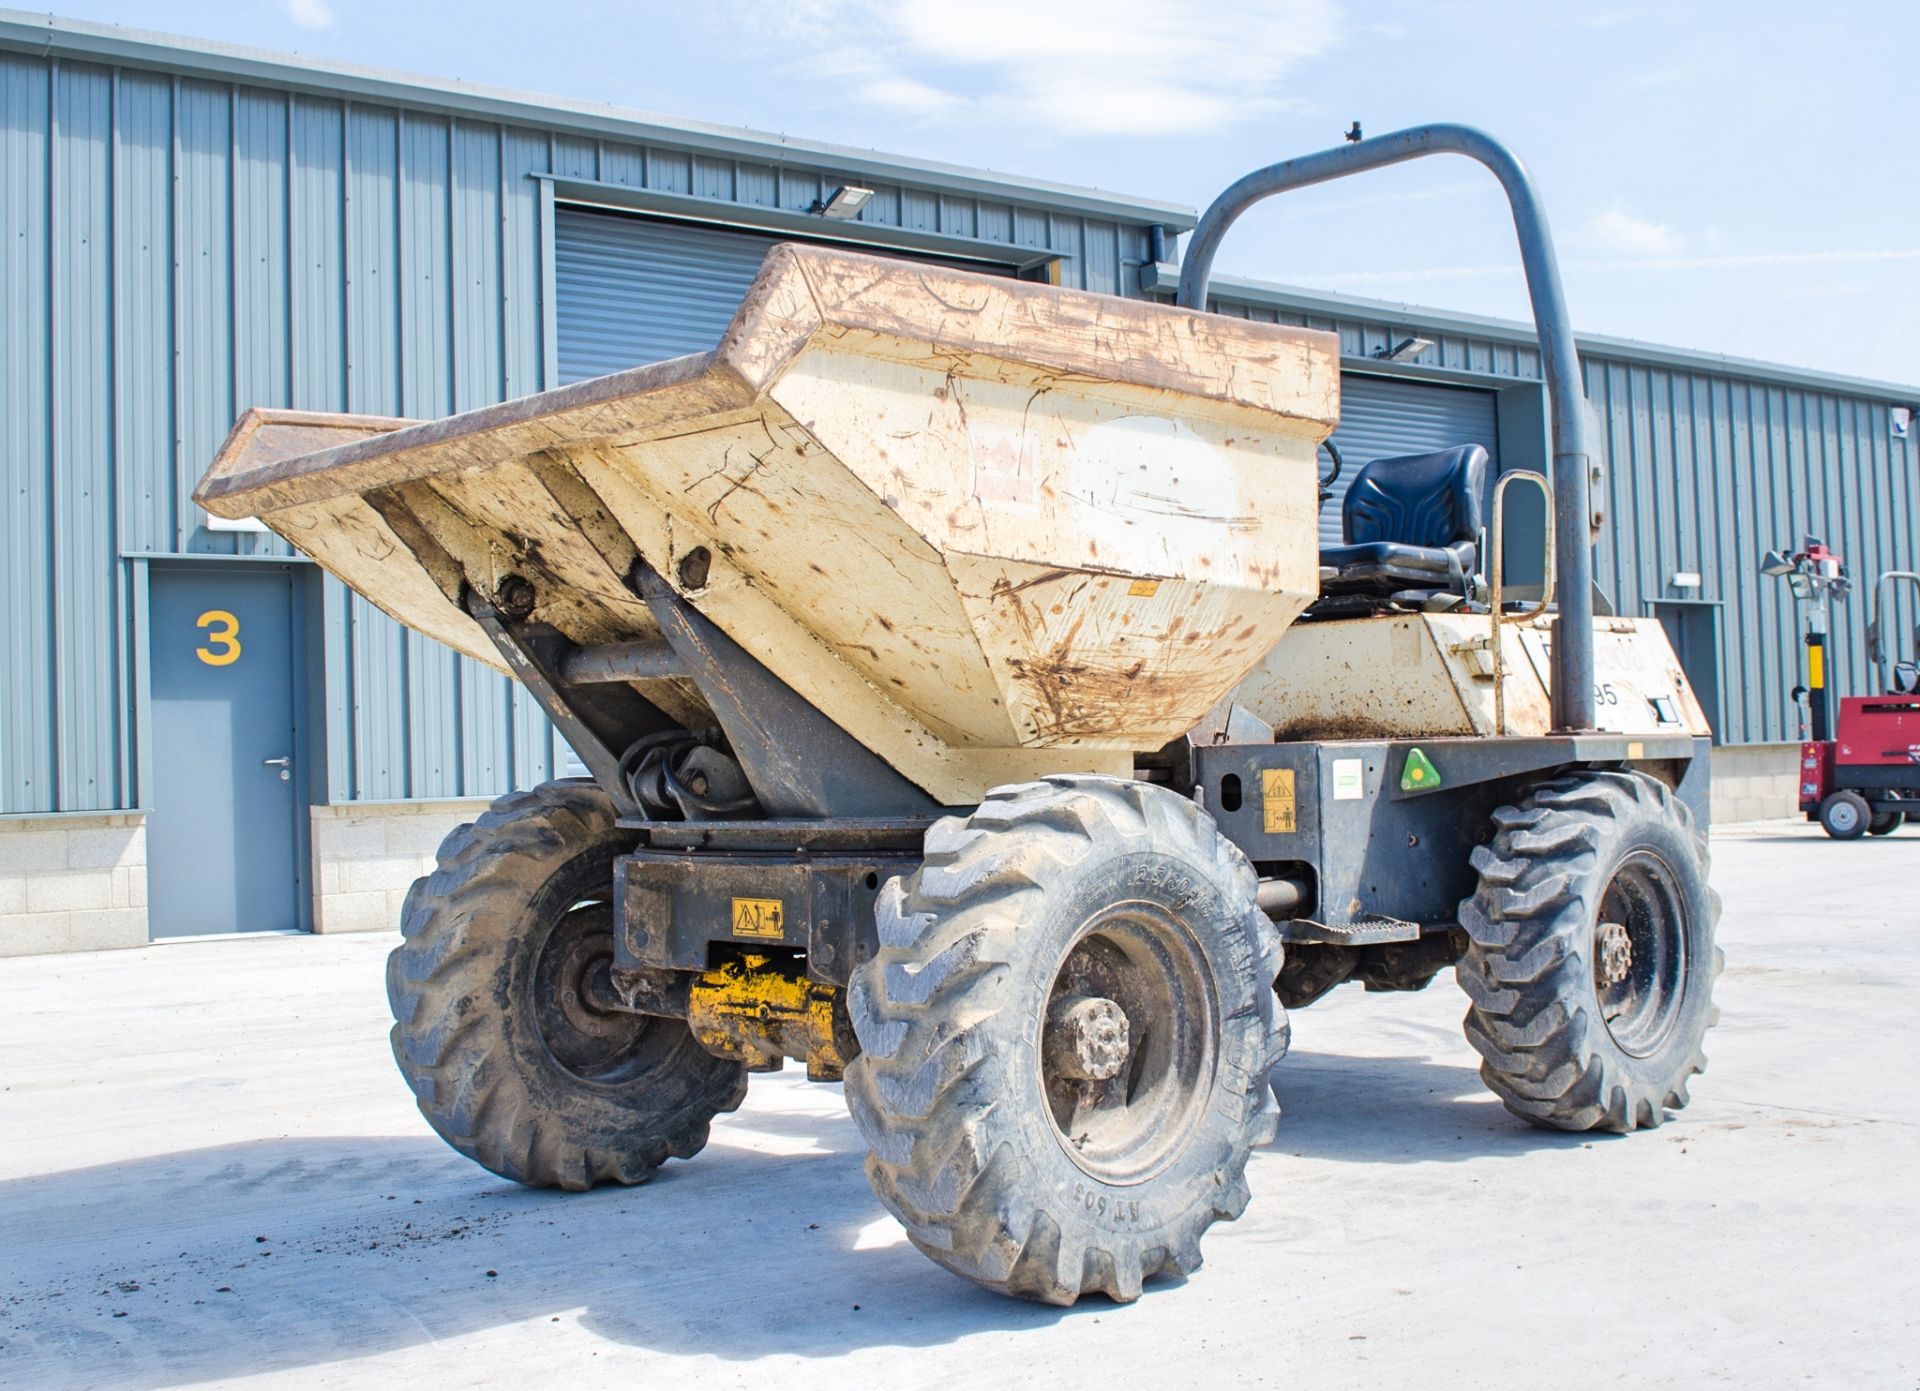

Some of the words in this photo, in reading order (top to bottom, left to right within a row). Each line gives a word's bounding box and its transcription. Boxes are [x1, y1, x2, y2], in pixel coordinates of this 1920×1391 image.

[196, 610, 242, 666] 3
[1073, 1182, 1108, 1218] 603
[1113, 1200, 1141, 1224] AT
